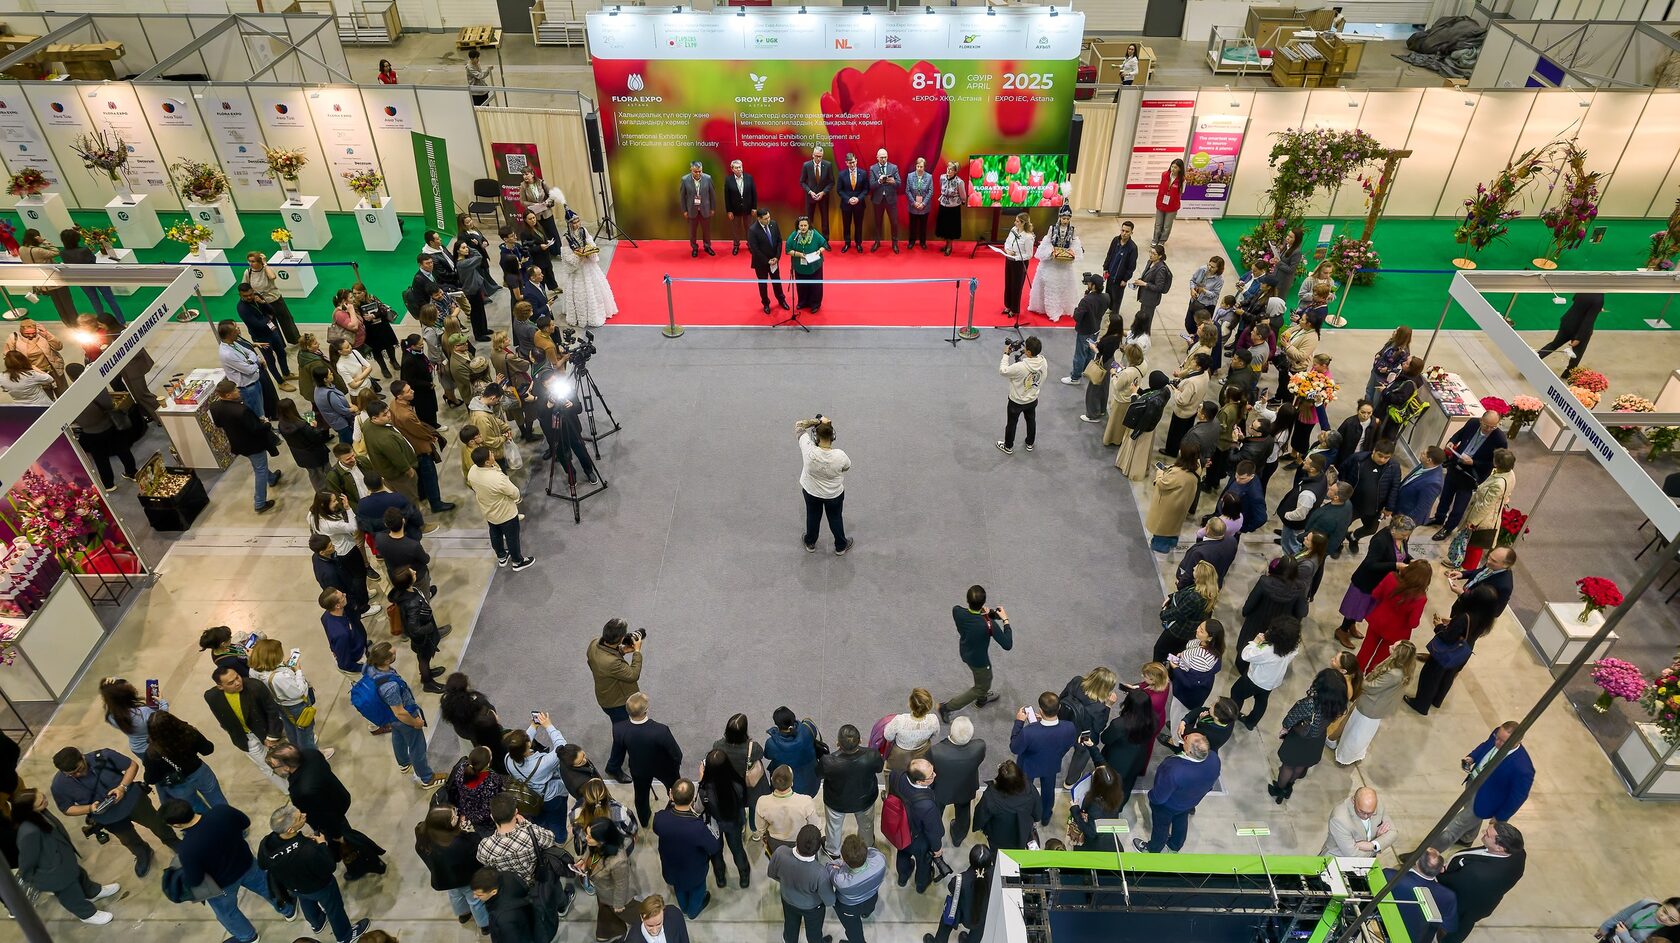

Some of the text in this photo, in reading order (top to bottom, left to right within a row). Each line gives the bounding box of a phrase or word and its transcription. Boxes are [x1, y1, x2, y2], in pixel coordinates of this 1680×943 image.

[835, 38, 852, 49] NL
[912, 73, 956, 89] 8-10
[1002, 73, 1054, 89] 2025
[99, 303, 169, 377] HOLLAND BULB MARKET B.V.
[1547, 385, 1614, 461] DERUITER INNOVATION
